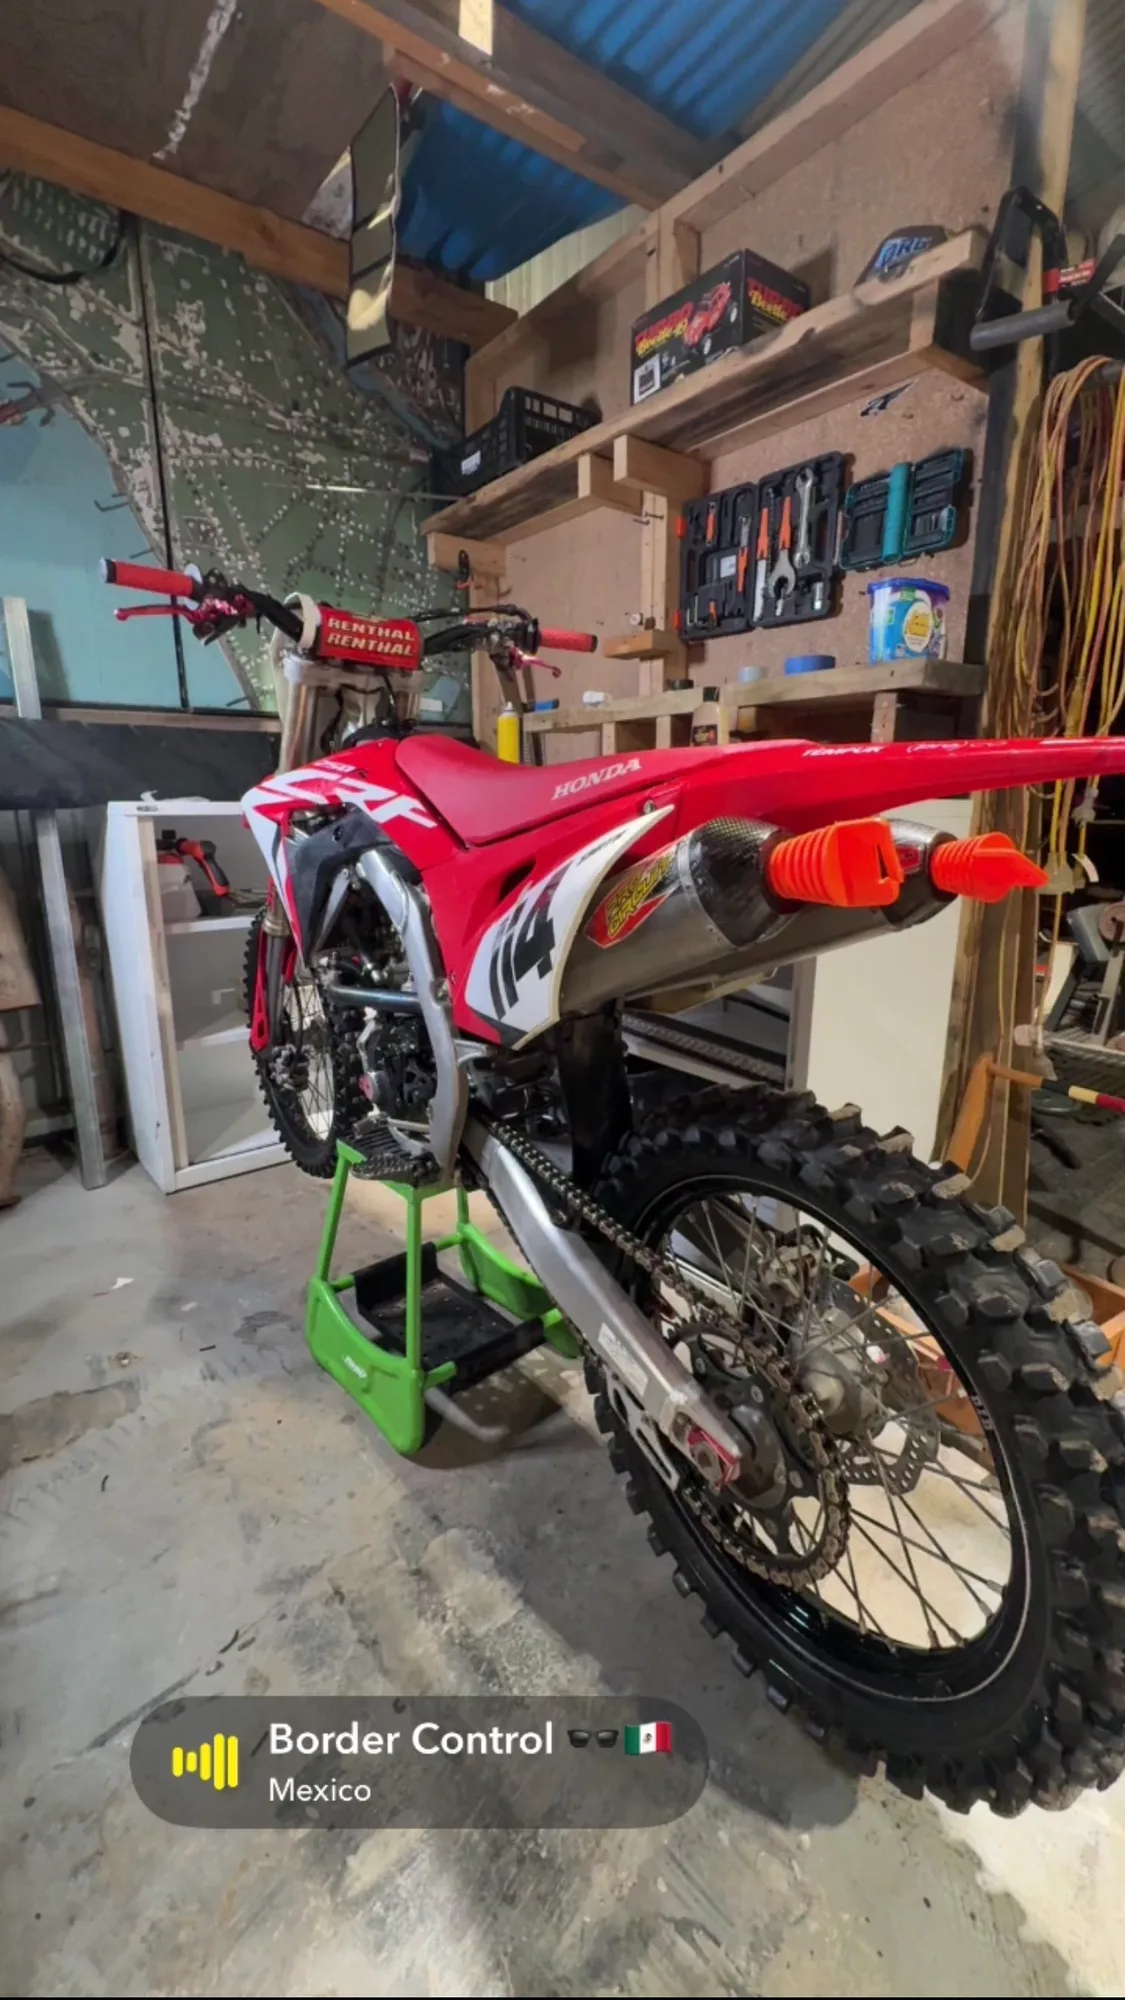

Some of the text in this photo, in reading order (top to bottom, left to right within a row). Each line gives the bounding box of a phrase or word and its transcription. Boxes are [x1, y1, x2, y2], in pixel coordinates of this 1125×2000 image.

[326, 632, 414, 656] RENTHAL
[328, 617, 416, 641] RENTHAL
[551, 757, 642, 802] HONDA
[259, 768, 438, 829] CRF
